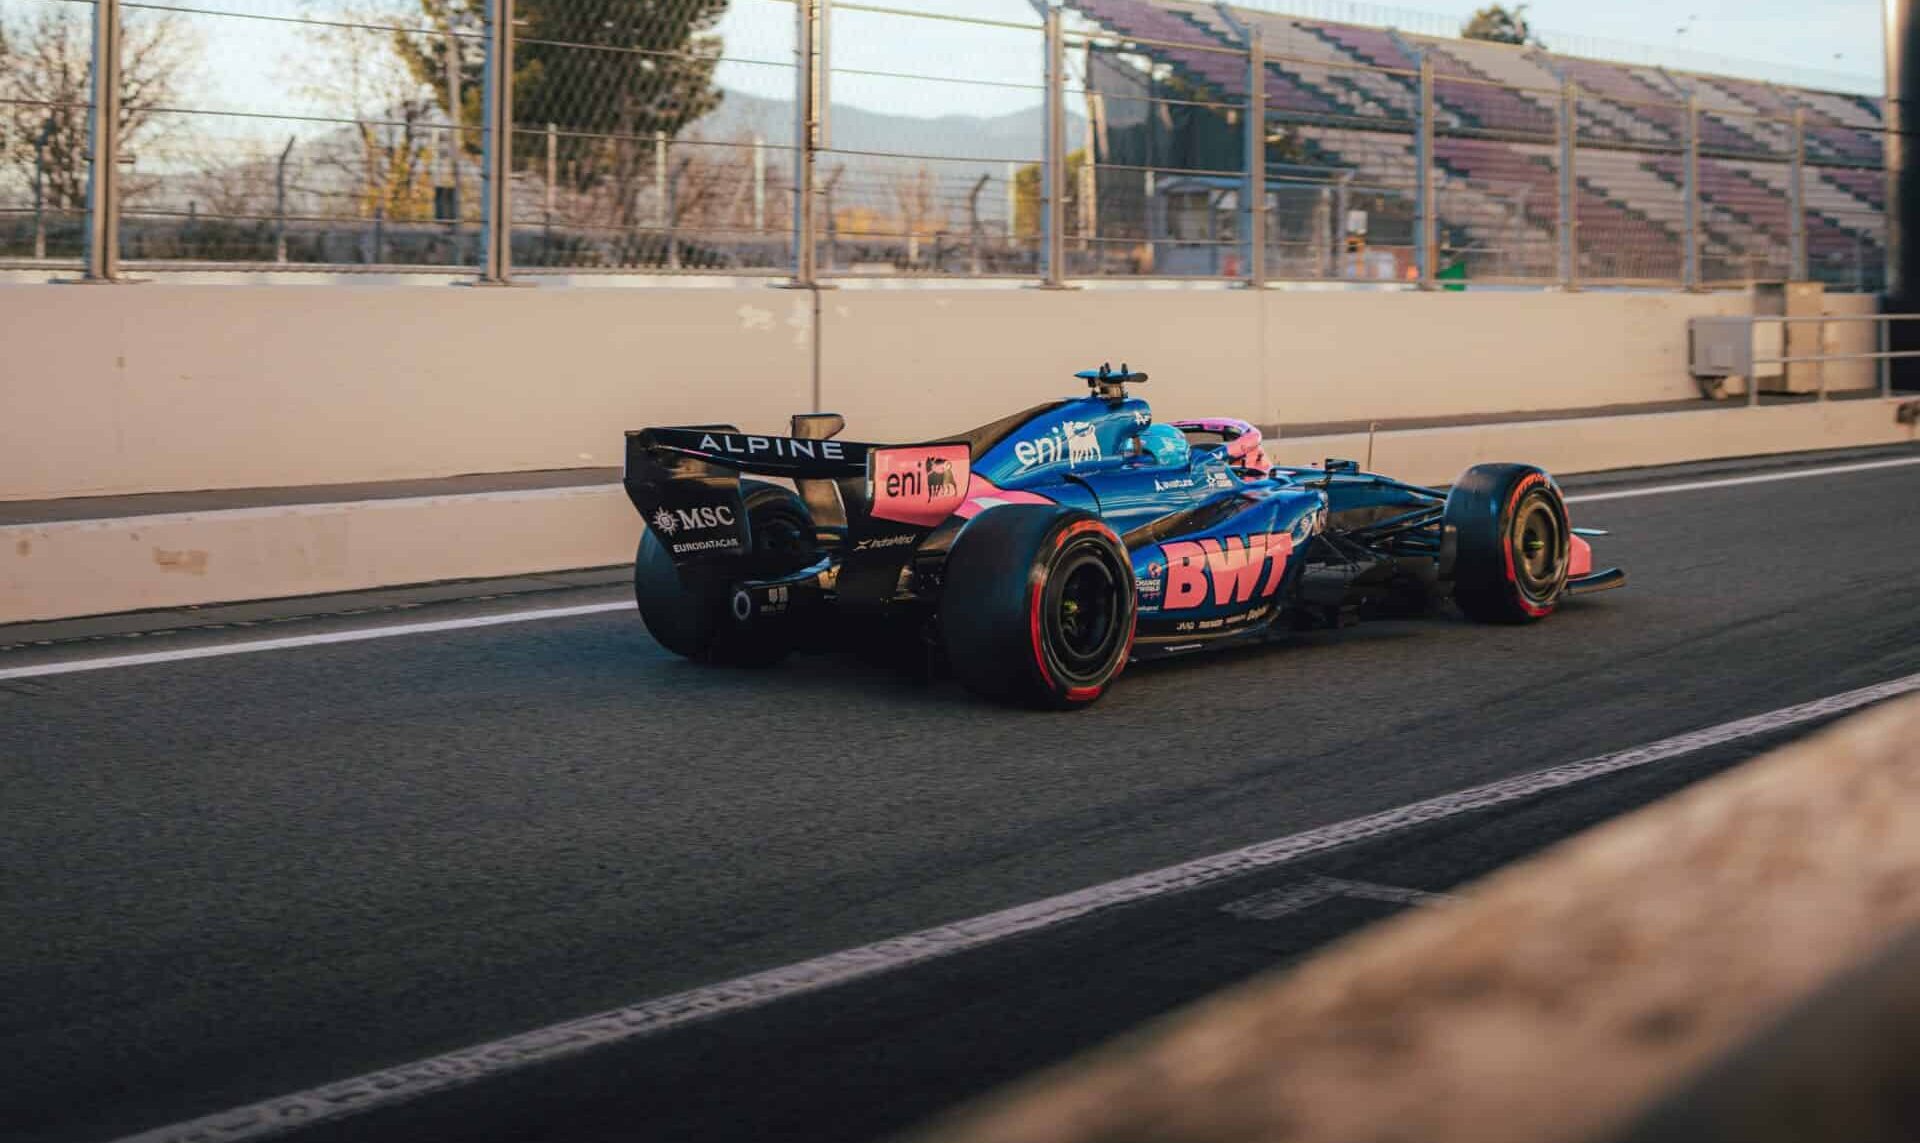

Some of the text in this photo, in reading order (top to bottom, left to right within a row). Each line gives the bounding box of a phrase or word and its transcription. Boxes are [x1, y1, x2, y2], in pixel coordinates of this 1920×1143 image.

[700, 434, 845, 460] ALPINE
[1015, 426, 1062, 467] eni
[886, 461, 922, 497] eni
[676, 506, 735, 530] MSC
[673, 538, 738, 553] EURODATACAR
[1160, 532, 1294, 609] BWT
